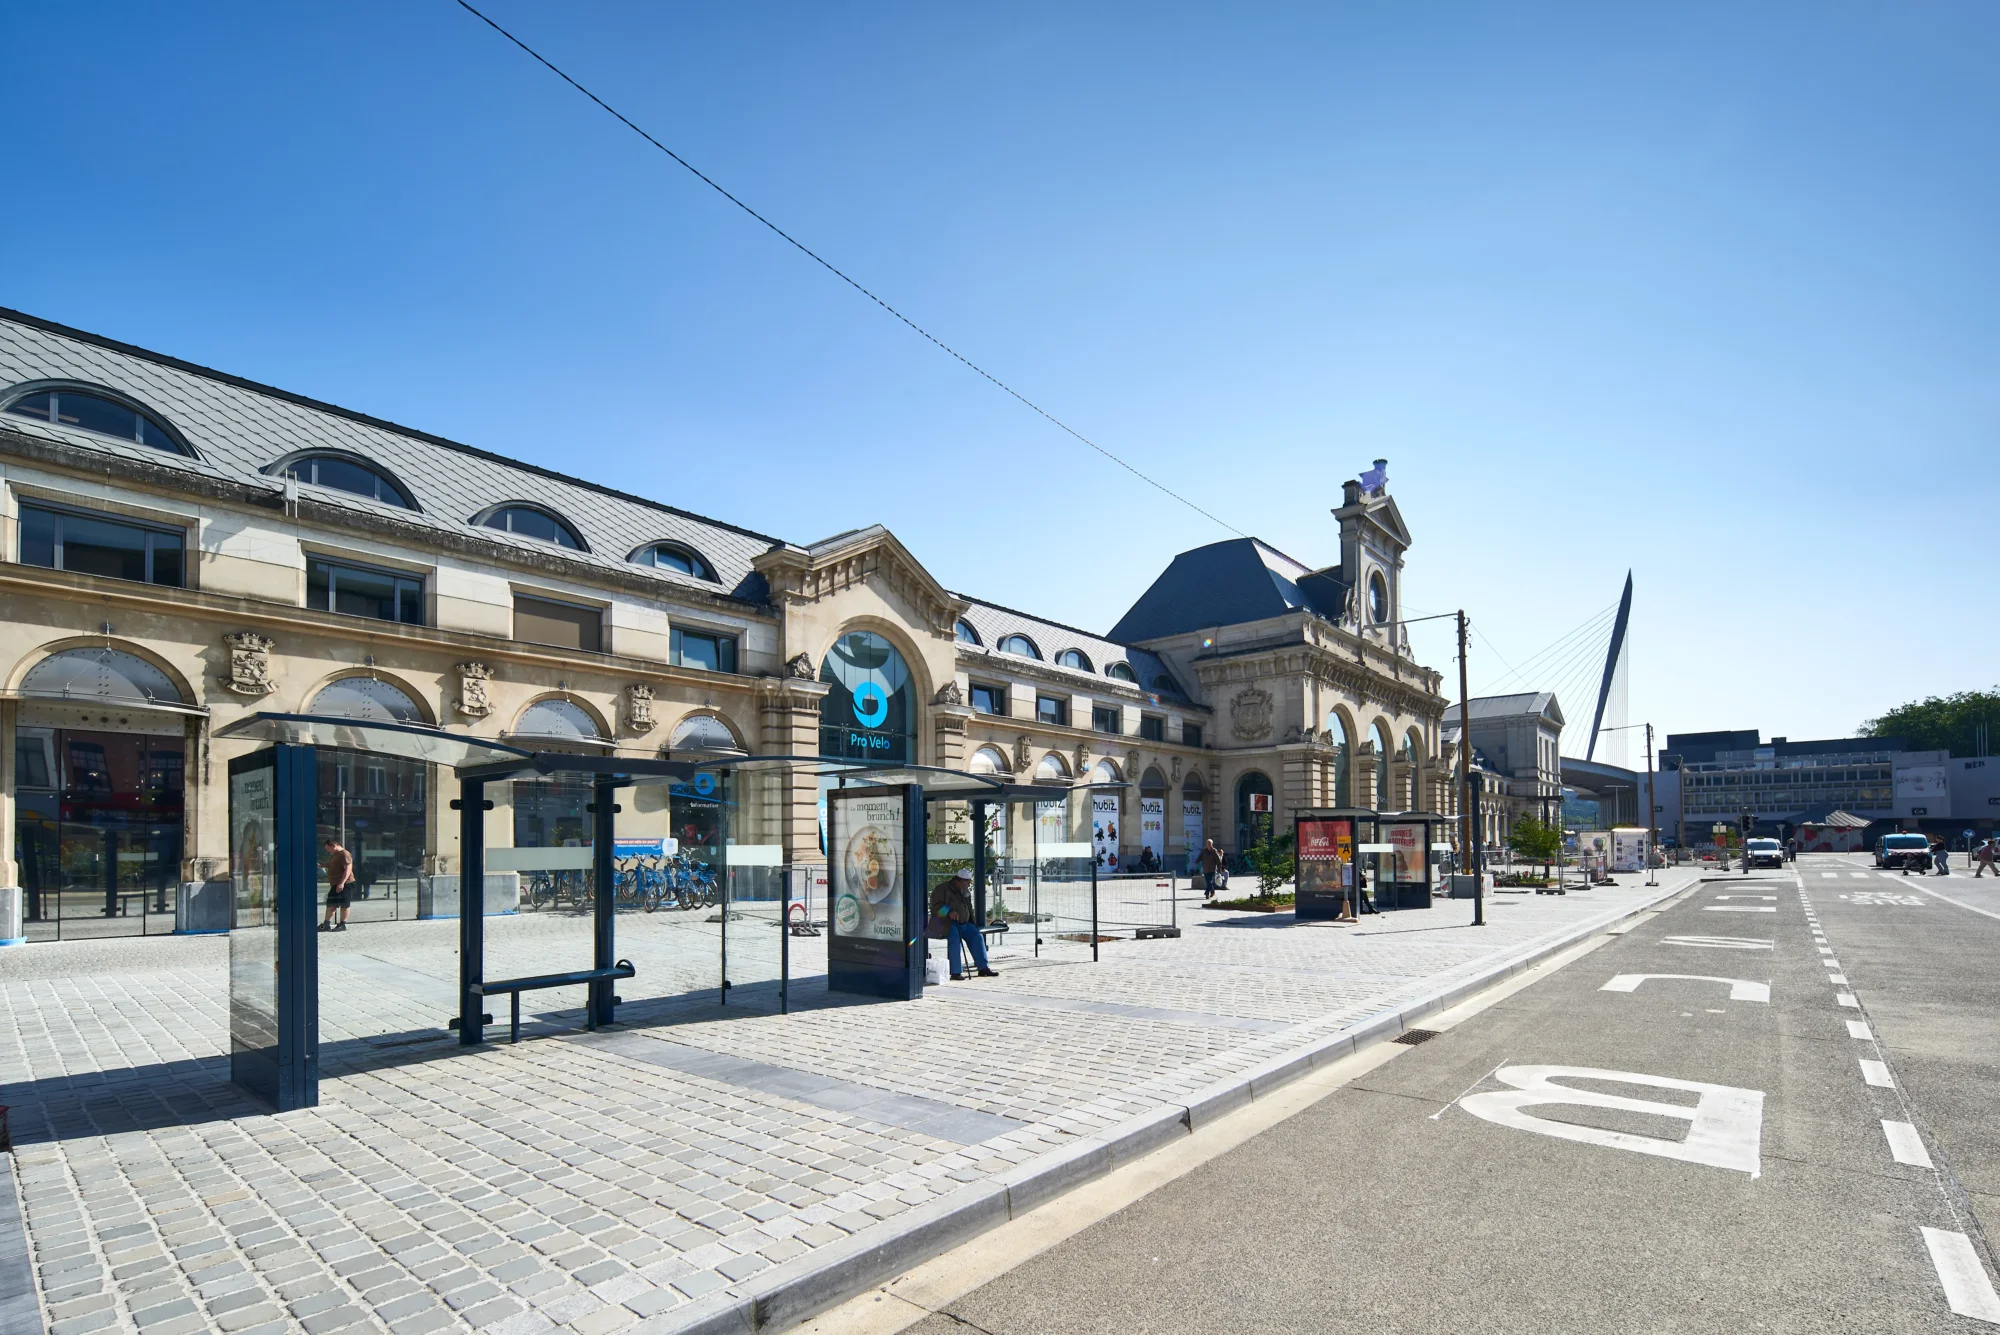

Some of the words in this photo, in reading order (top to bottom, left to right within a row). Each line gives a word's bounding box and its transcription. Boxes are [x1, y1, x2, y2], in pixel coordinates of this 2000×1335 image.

[851, 733, 867, 747] Pro
[869, 735, 890, 749] Velo
[857, 802, 889, 812] moment
[1093, 799, 1117, 811] hubiz
[1141, 801, 1162, 812] hubiz
[1183, 804, 1201, 814] hubiz
[1343, 844, 1350, 854] A
